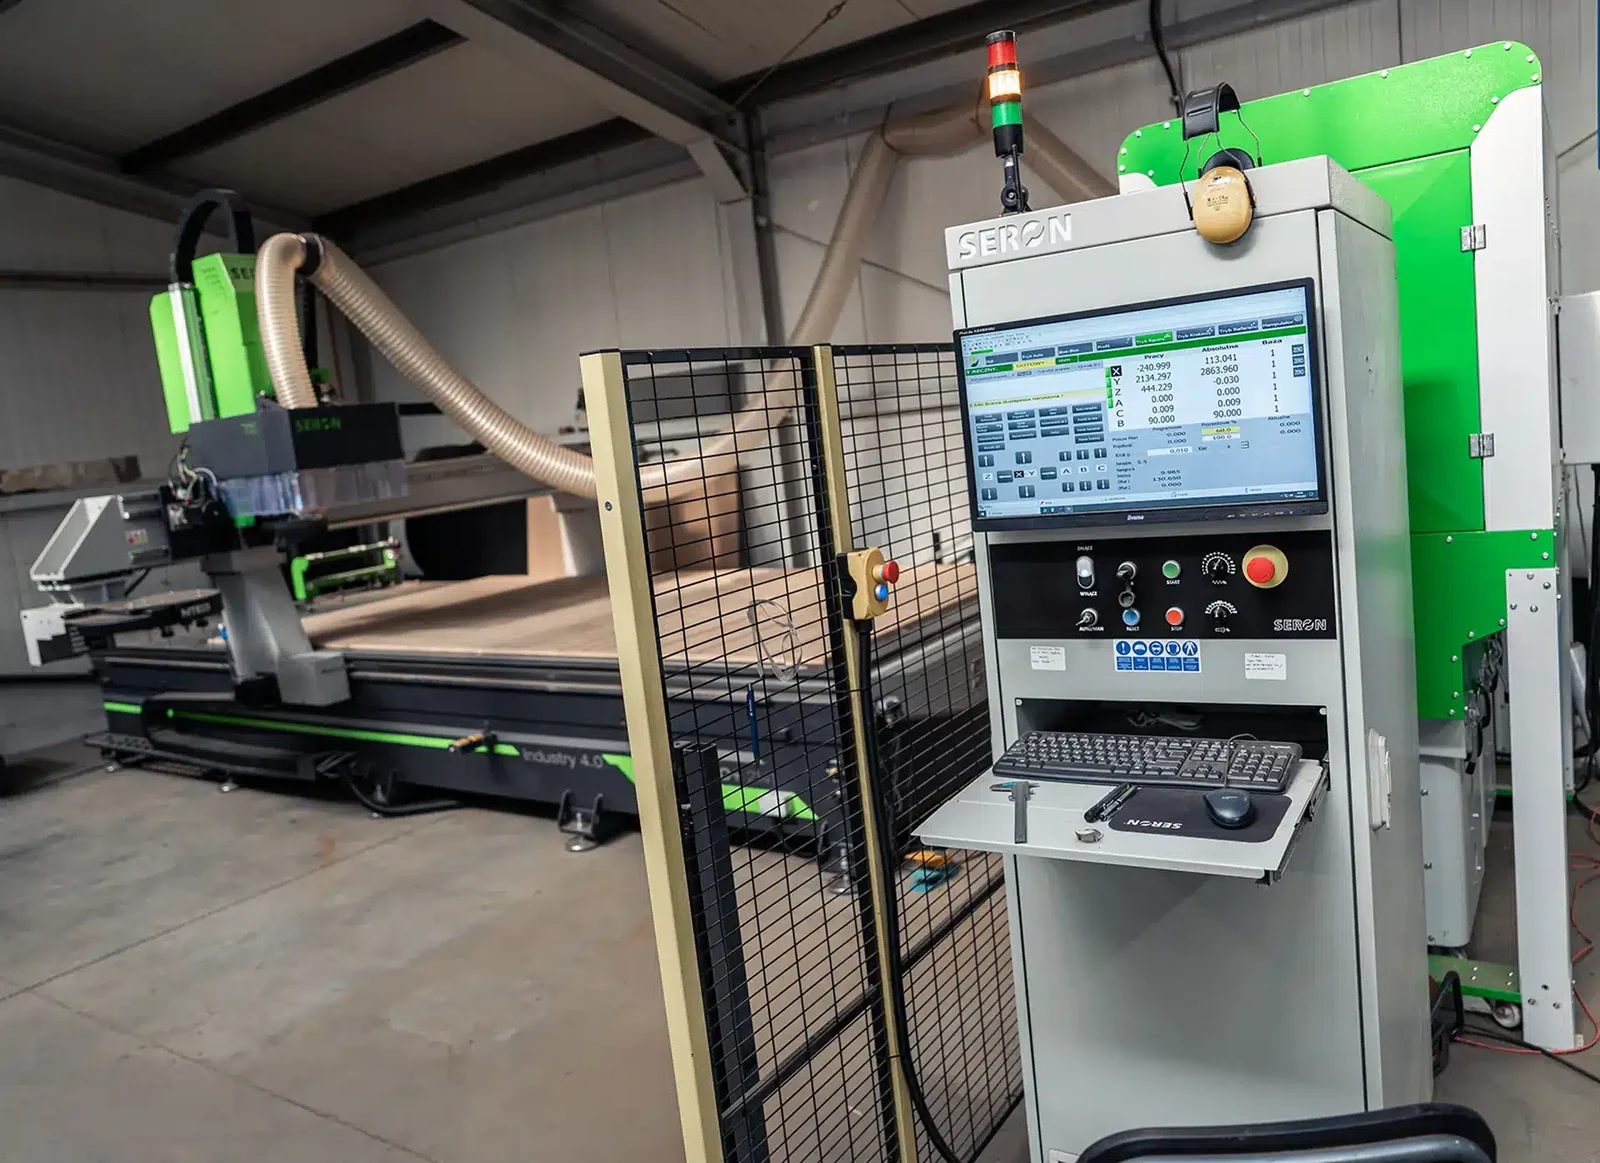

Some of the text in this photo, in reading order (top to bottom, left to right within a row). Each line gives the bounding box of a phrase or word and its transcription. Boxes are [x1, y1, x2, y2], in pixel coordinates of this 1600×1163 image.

[958, 213, 1072, 260] SERON
[1201, 344, 1239, 352] Absolutne
[1113, 360, 1276, 386] Y 2134.297 2863.960 1
[1136, 361, 1171, 373] -240.999
[1205, 353, 1237, 365] 113.041
[1271, 349, 1275, 357] 1
[1114, 371, 1277, 396] Z 444.229 -0.030 1
[1115, 383, 1278, 407] A 0.000 0.000 1
[1116, 394, 1279, 418] C 0.009 0.009 1
[1117, 405, 1279, 428] B 90.000 90.000 1
[1273, 618, 1327, 631] SERON
[523, 750, 604, 769] Industry 4.0
[1126, 819, 1183, 829] SERON
